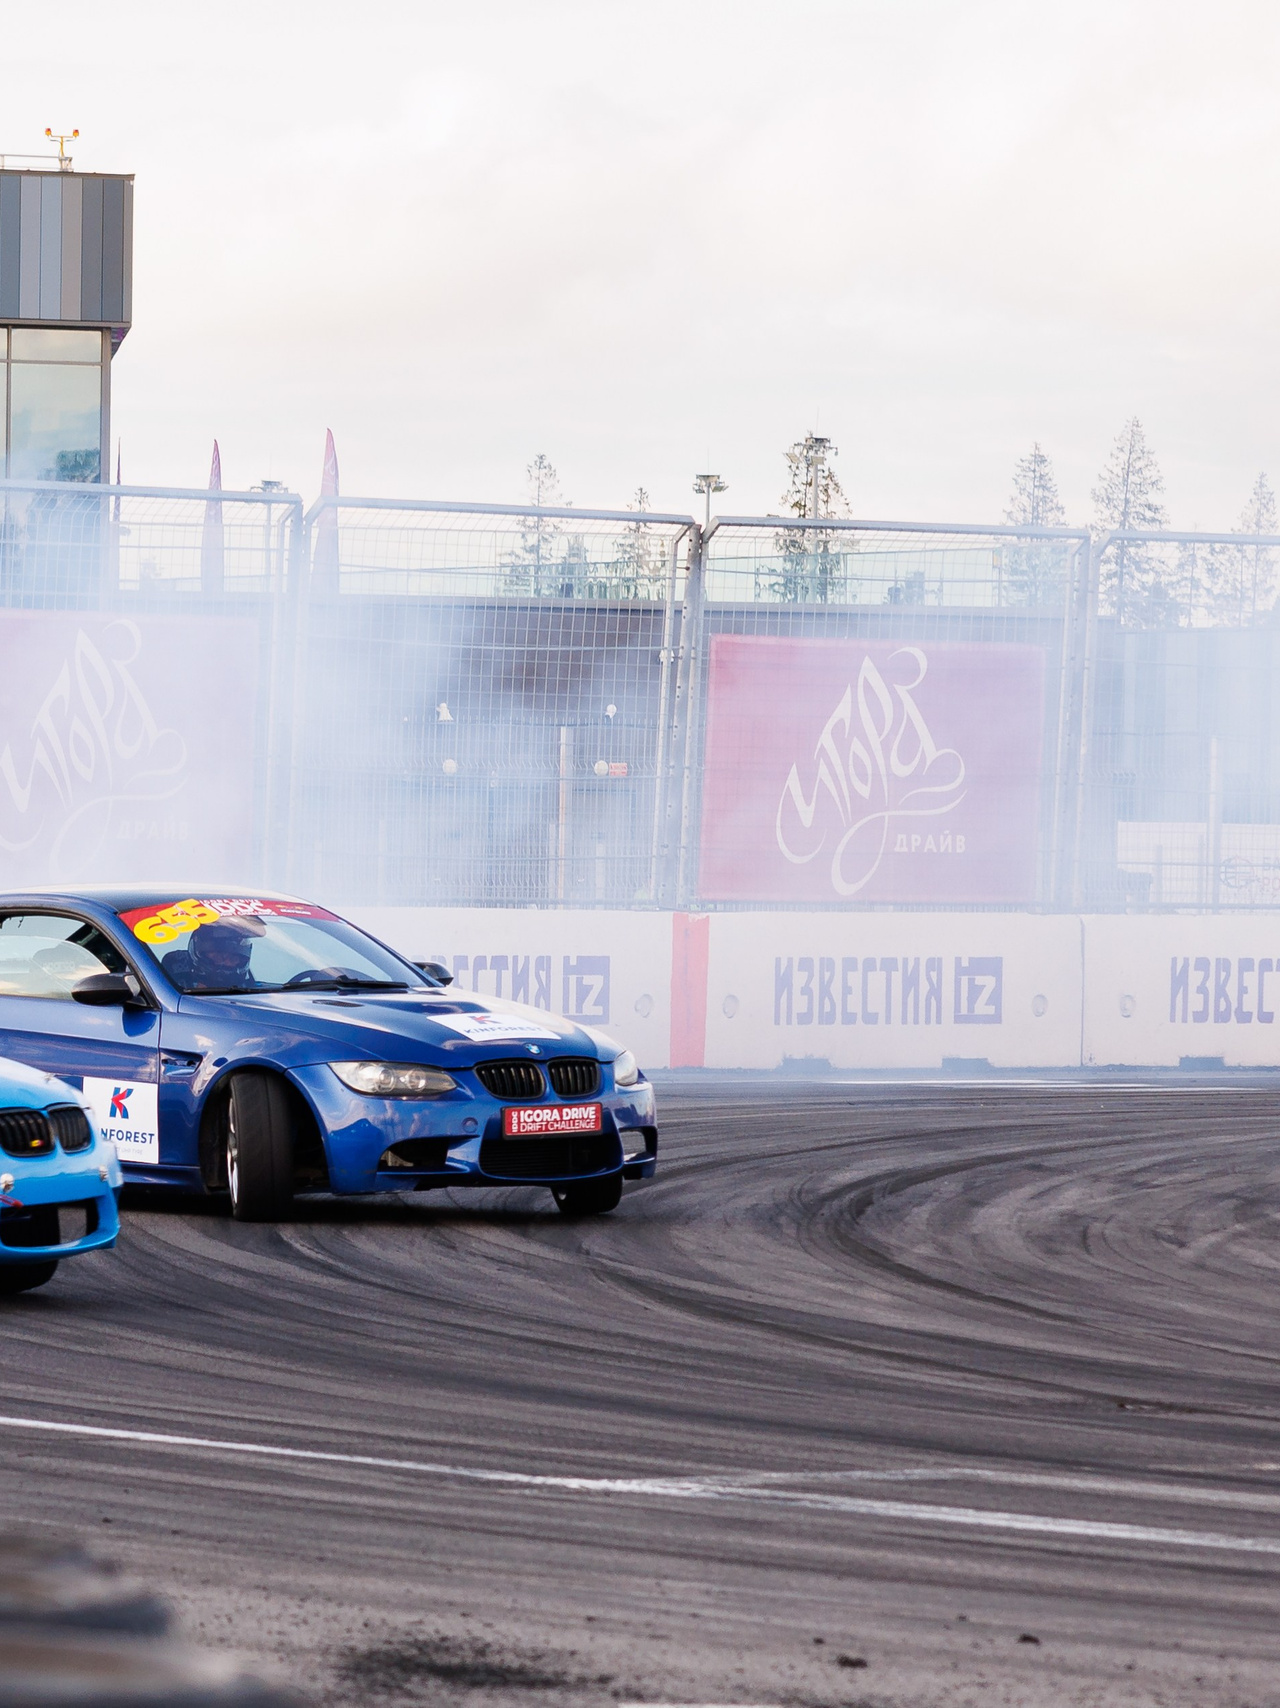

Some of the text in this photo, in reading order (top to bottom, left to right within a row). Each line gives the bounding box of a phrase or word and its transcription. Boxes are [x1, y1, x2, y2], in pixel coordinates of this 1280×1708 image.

[894, 830, 966, 854] ДРАЙВ
[133, 898, 220, 944] 655
[773, 956, 943, 1025] ИЗВЕСТИЯ
[1169, 956, 1280, 1024] ИЗВЕС
[520, 1106, 596, 1122] IGORA DRIVE
[520, 1119, 596, 1132] DRIFT CHALLENGE
[101, 1128, 155, 1144] NFOREST
